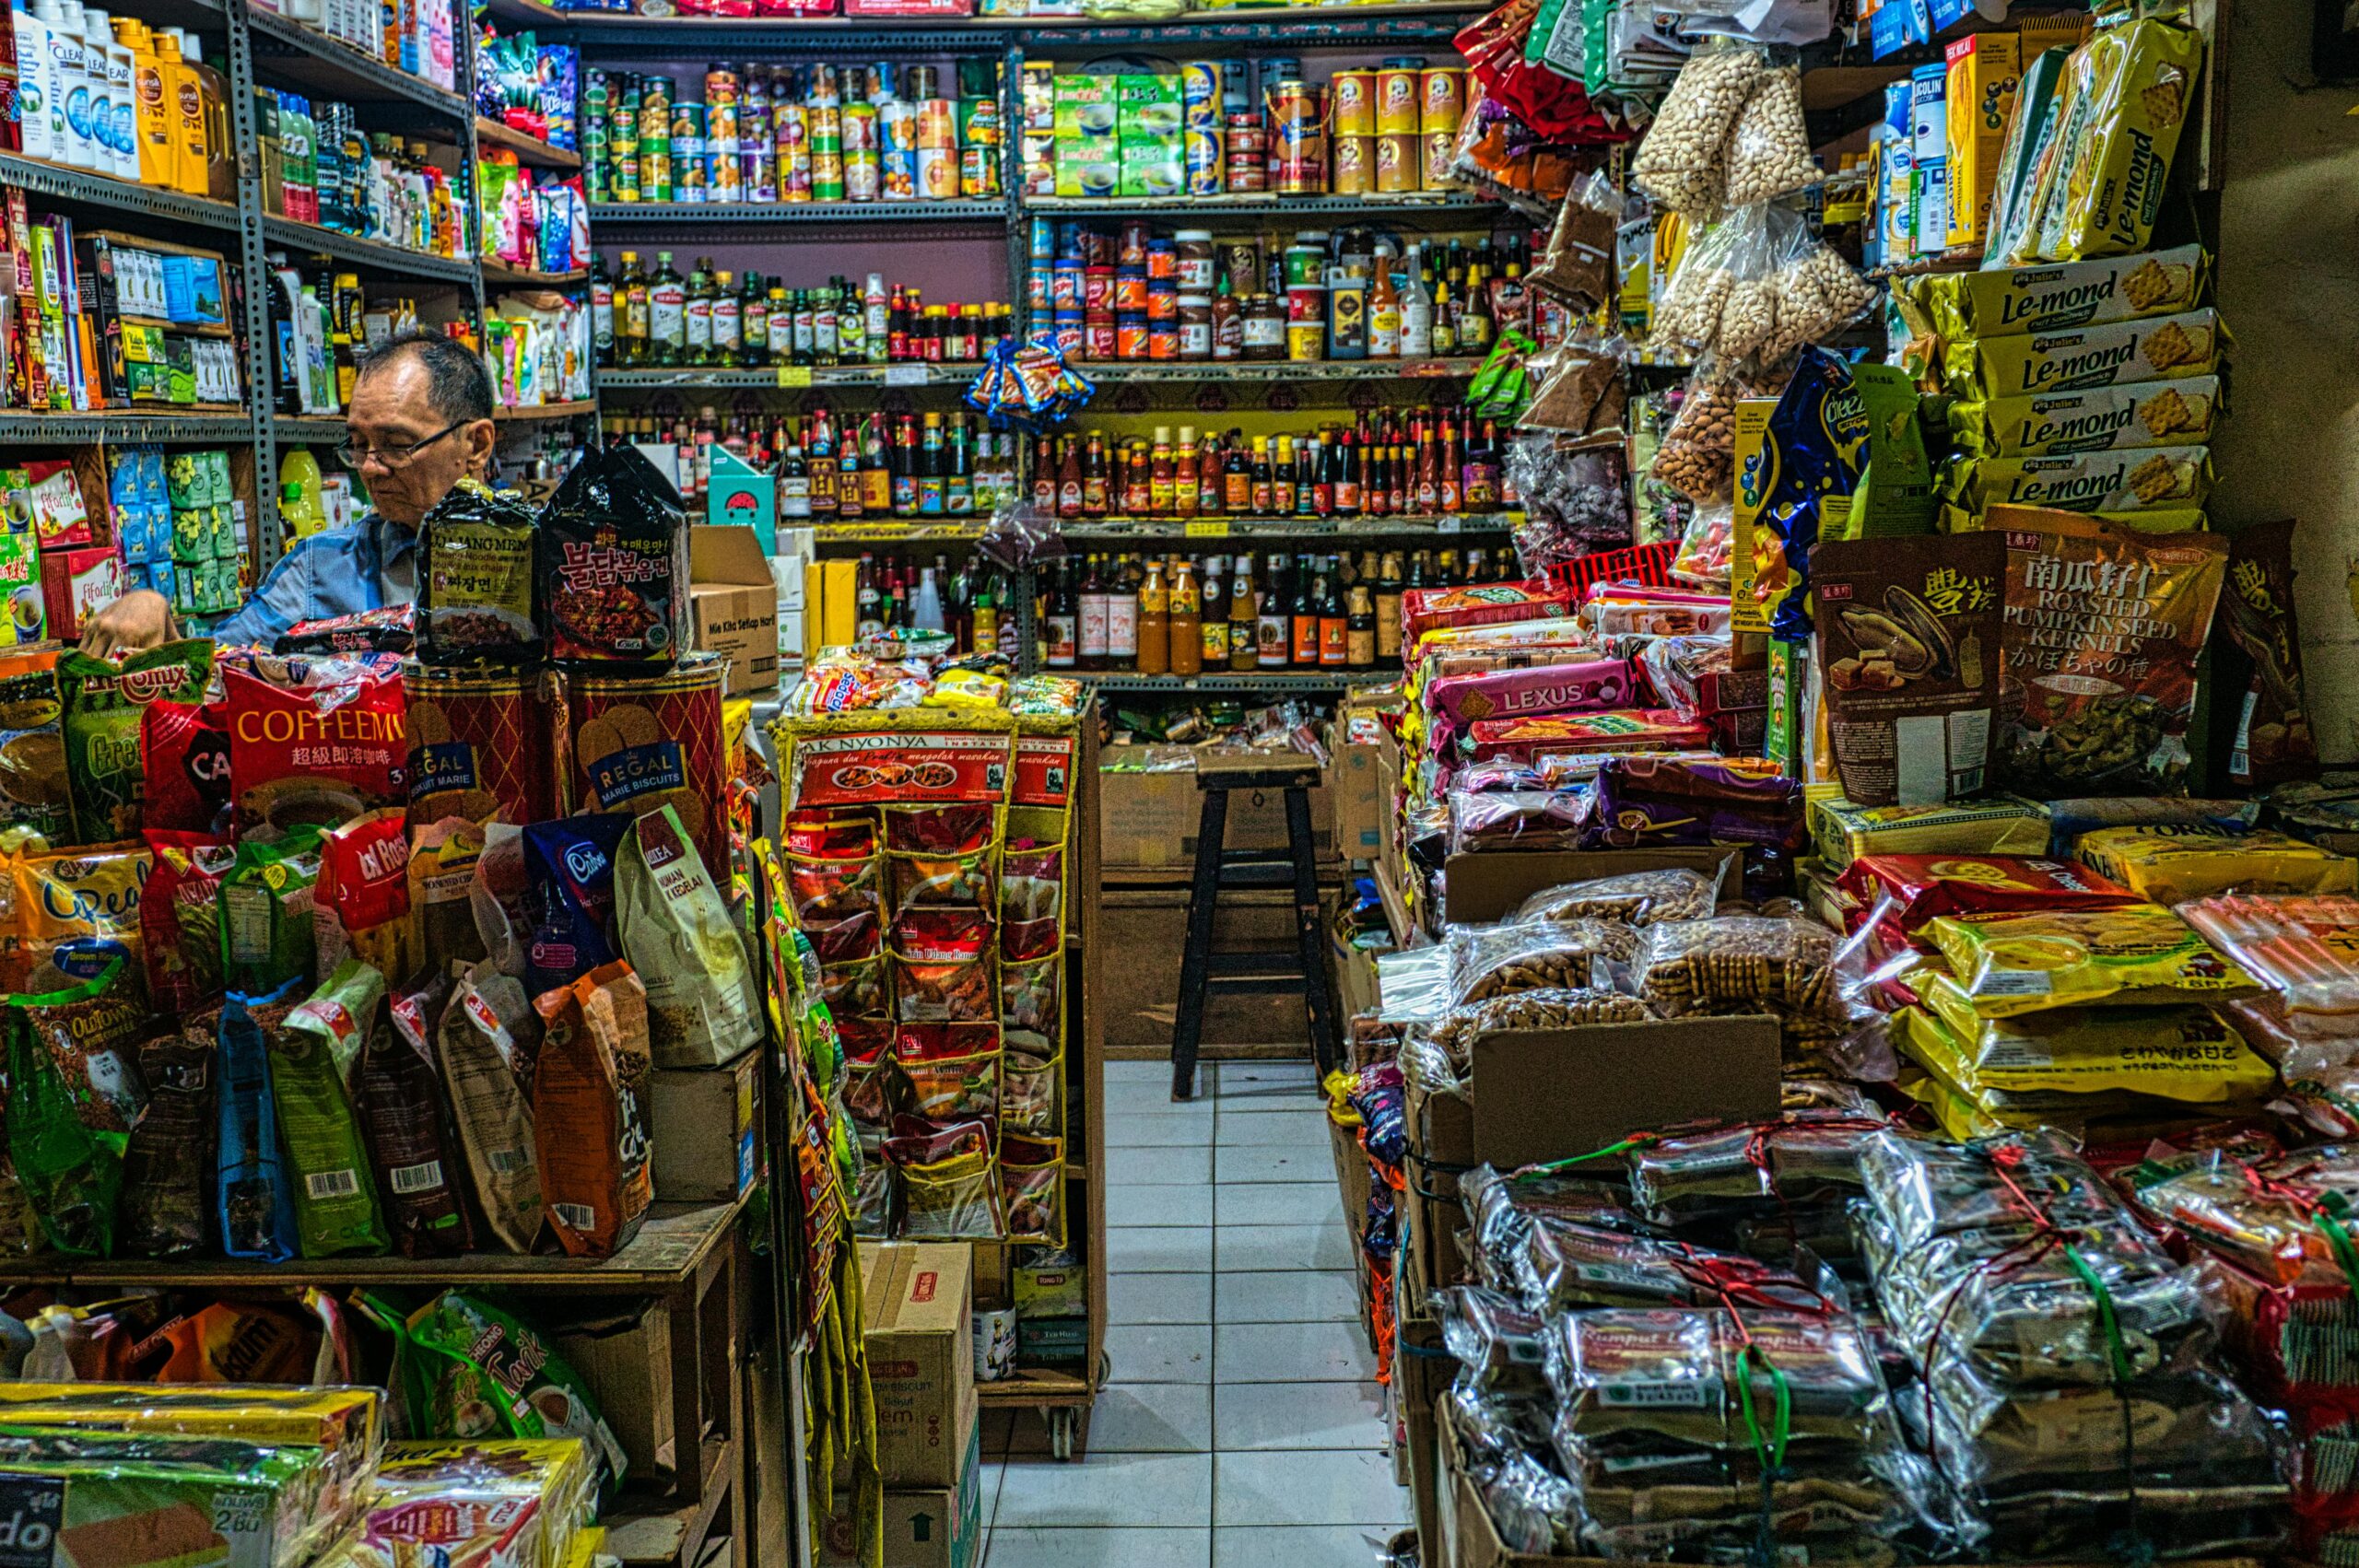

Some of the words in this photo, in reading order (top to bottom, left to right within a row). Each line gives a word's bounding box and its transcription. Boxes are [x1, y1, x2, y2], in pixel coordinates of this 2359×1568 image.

[53, 44, 85, 63] CLEAR
[109, 68, 129, 81] EAR
[2109, 126, 2154, 246] Le-mond
[2001, 270, 2118, 325] Le-mond
[2022, 333, 2139, 391] Le-mond
[2019, 397, 2136, 449] Le-mond
[2007, 462, 2126, 504] Le-mond
[558, 542, 670, 591] 불닭볶음면
[2037, 590, 2151, 619] ROASTED
[709, 622, 722, 635] Mie
[722, 620, 737, 633] Kita
[738, 617, 759, 631] Setiap
[2003, 604, 2114, 634] PUMPKIN
[2118, 617, 2177, 641] SEED
[2028, 626, 2145, 656] KERNELS
[2009, 646, 2150, 681] かぼちゃの種
[1504, 685, 1583, 710] LEXUS
[237, 709, 406, 743] COFFEEMI
[290, 746, 392, 766] 超級即溶咖啡
[804, 738, 834, 753] AK
[839, 735, 929, 752] NYONYA
[957, 752, 1001, 763] masakan
[191, 751, 232, 781] CA
[437, 773, 471, 786] MARIE
[599, 754, 674, 789] REGAL
[601, 785, 631, 804] MARIE
[631, 772, 681, 790] BISCUITS
[673, 874, 705, 900] KEDELAI
[469, 1325, 504, 1362] HEONG
[0, 1509, 52, 1551] do
[214, 1509, 231, 1532] 2
